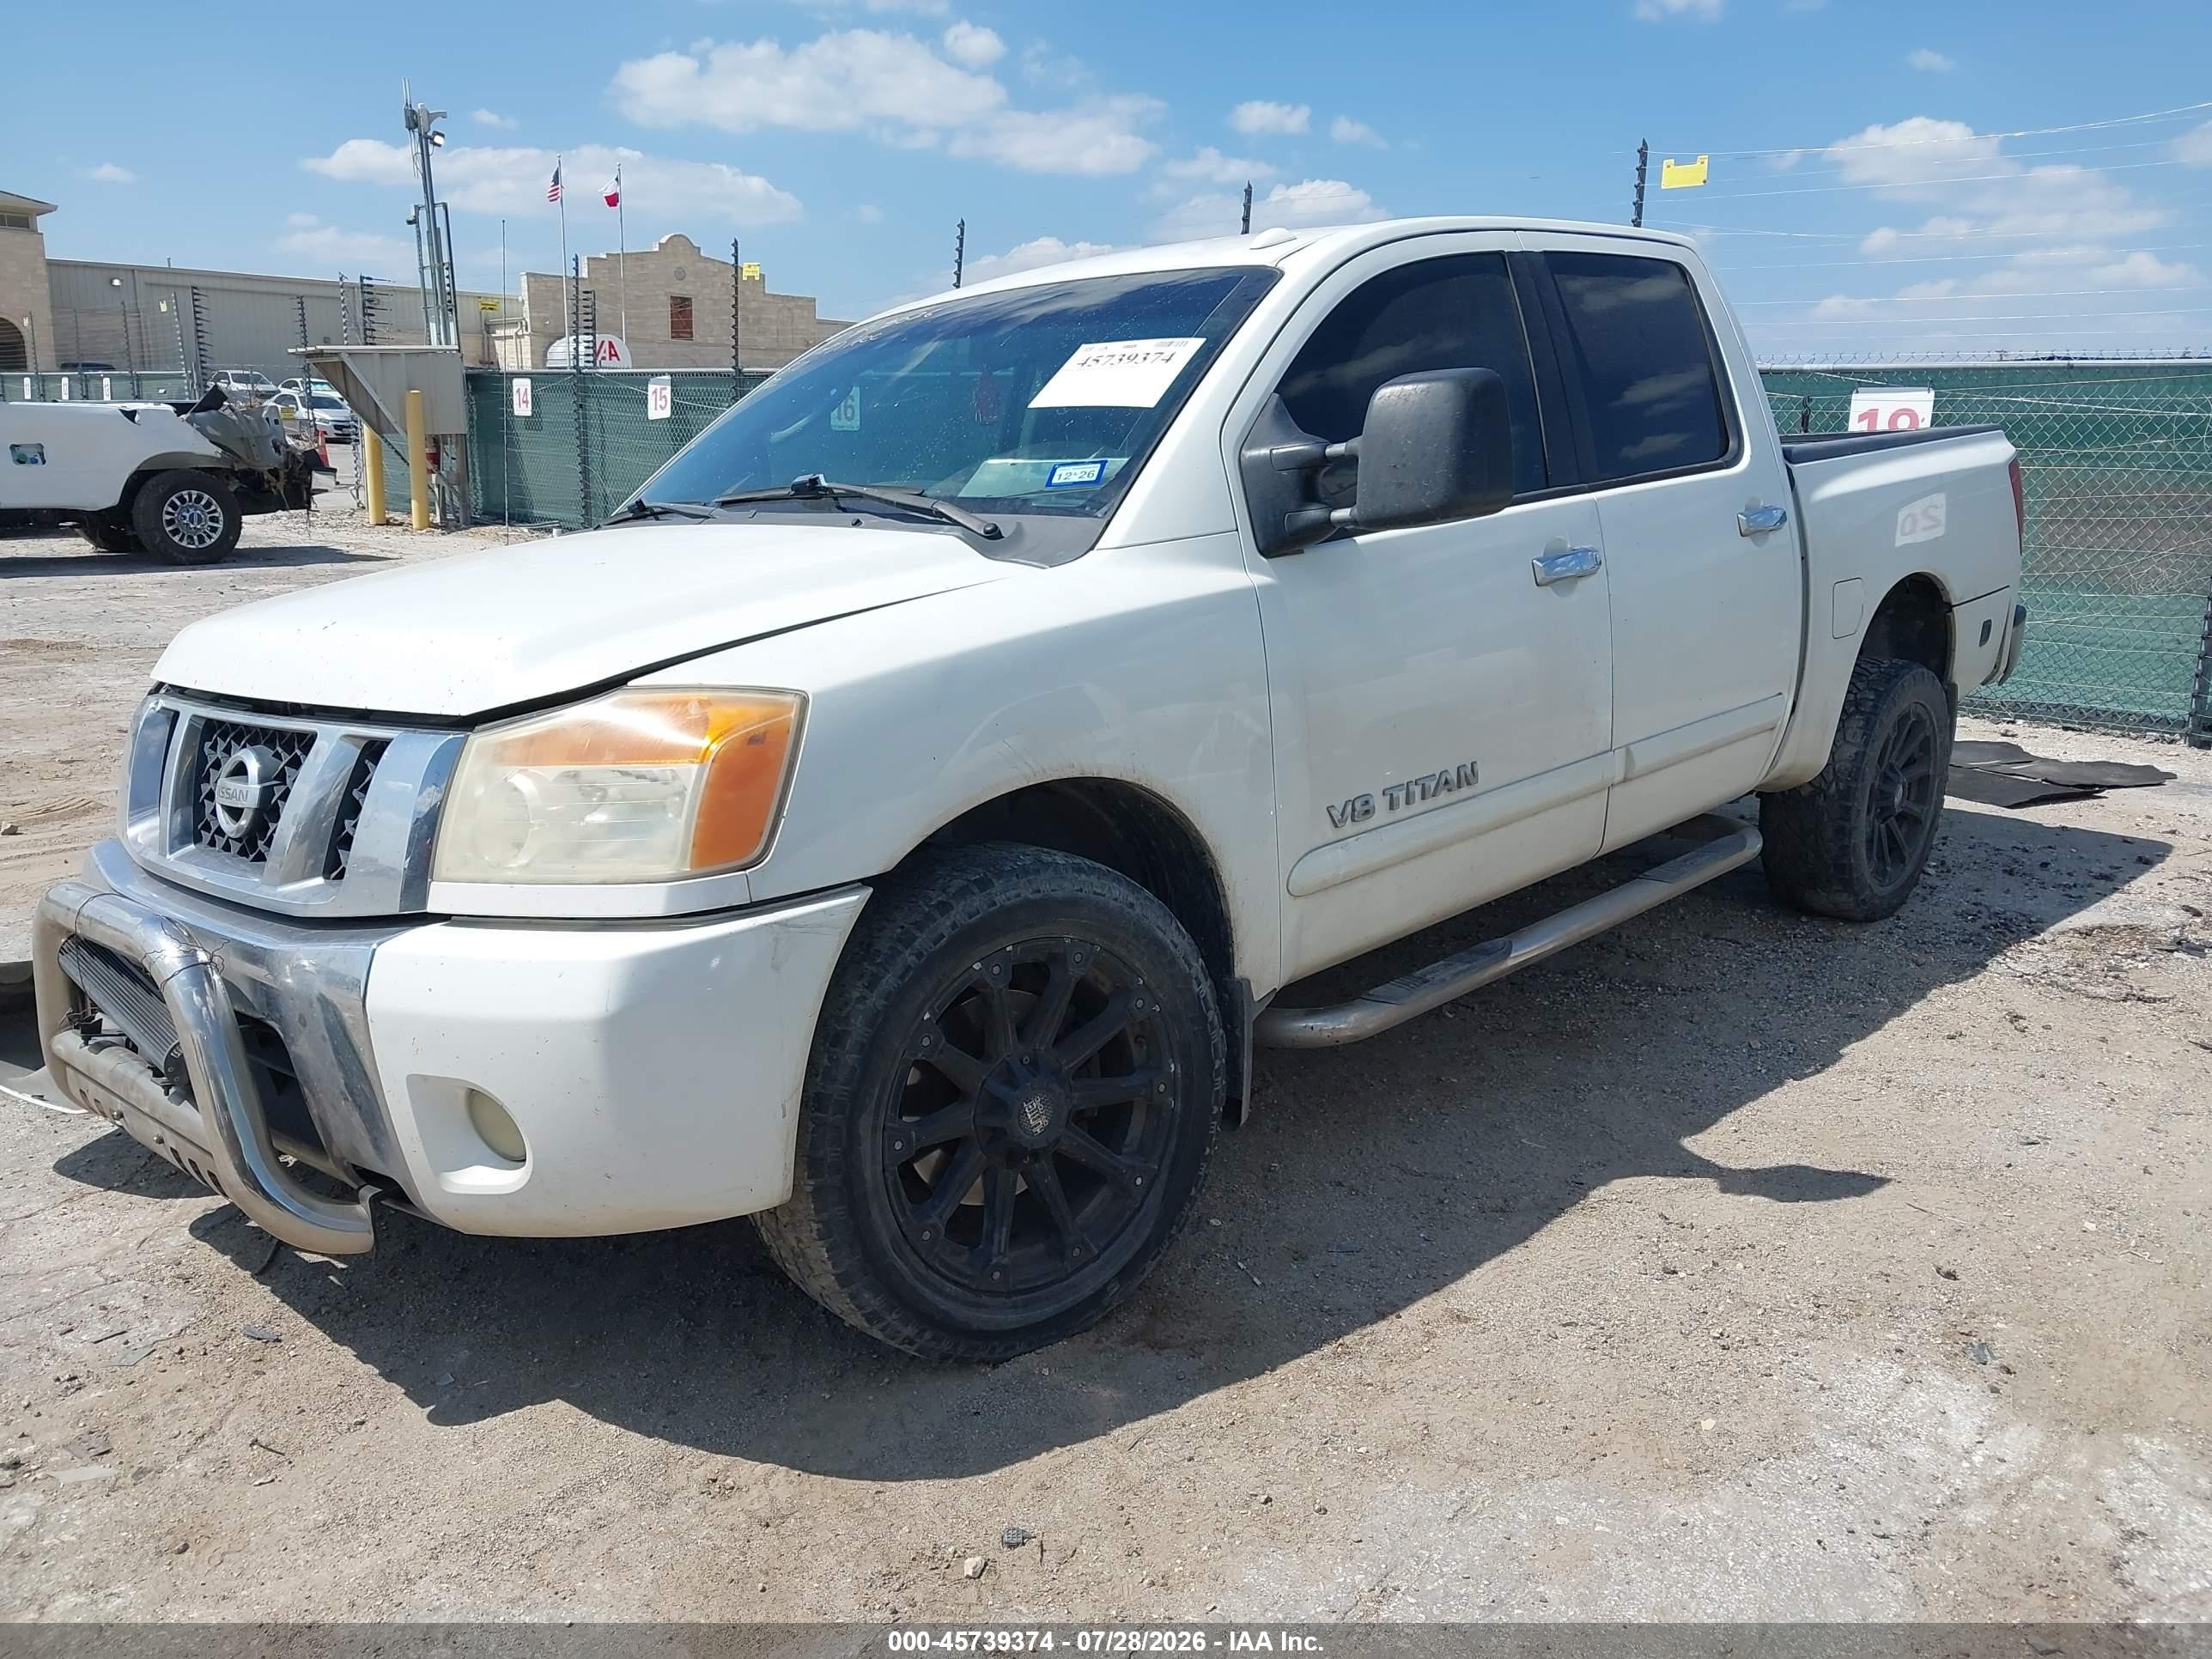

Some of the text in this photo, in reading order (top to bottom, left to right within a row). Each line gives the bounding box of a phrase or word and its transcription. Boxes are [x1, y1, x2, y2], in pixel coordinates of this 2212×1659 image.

[516, 387, 529, 409] 14
[651, 386, 668, 410] 15
[837, 394, 855, 422] 16
[1326, 761, 1479, 829] V8 TITAN
